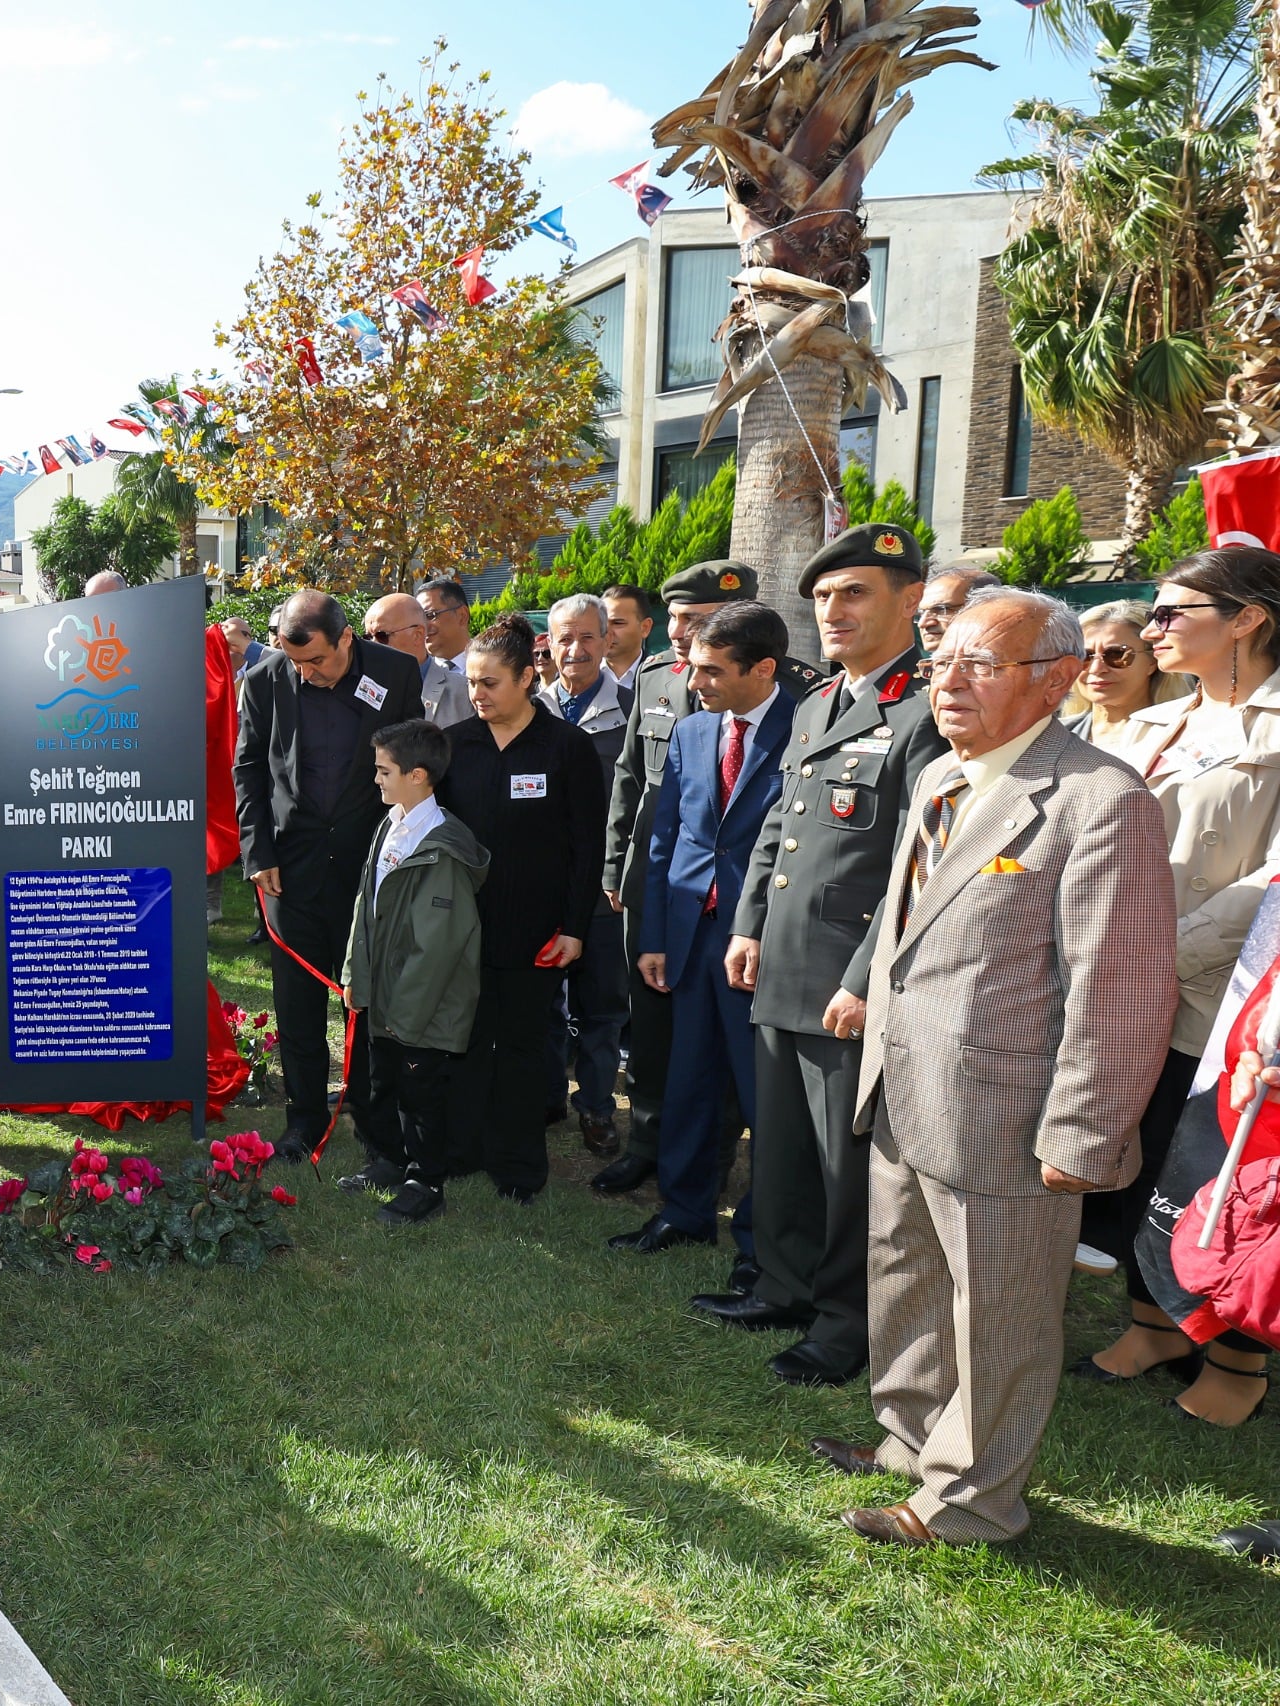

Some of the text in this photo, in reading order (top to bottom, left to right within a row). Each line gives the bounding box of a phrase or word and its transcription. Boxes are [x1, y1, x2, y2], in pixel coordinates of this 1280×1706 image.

[30, 765, 141, 796] Şehit Teğmen
[4, 803, 46, 825] Emre
[50, 795, 194, 825] FIRINCIOĞULLARI
[62, 836, 112, 858] PARKI
